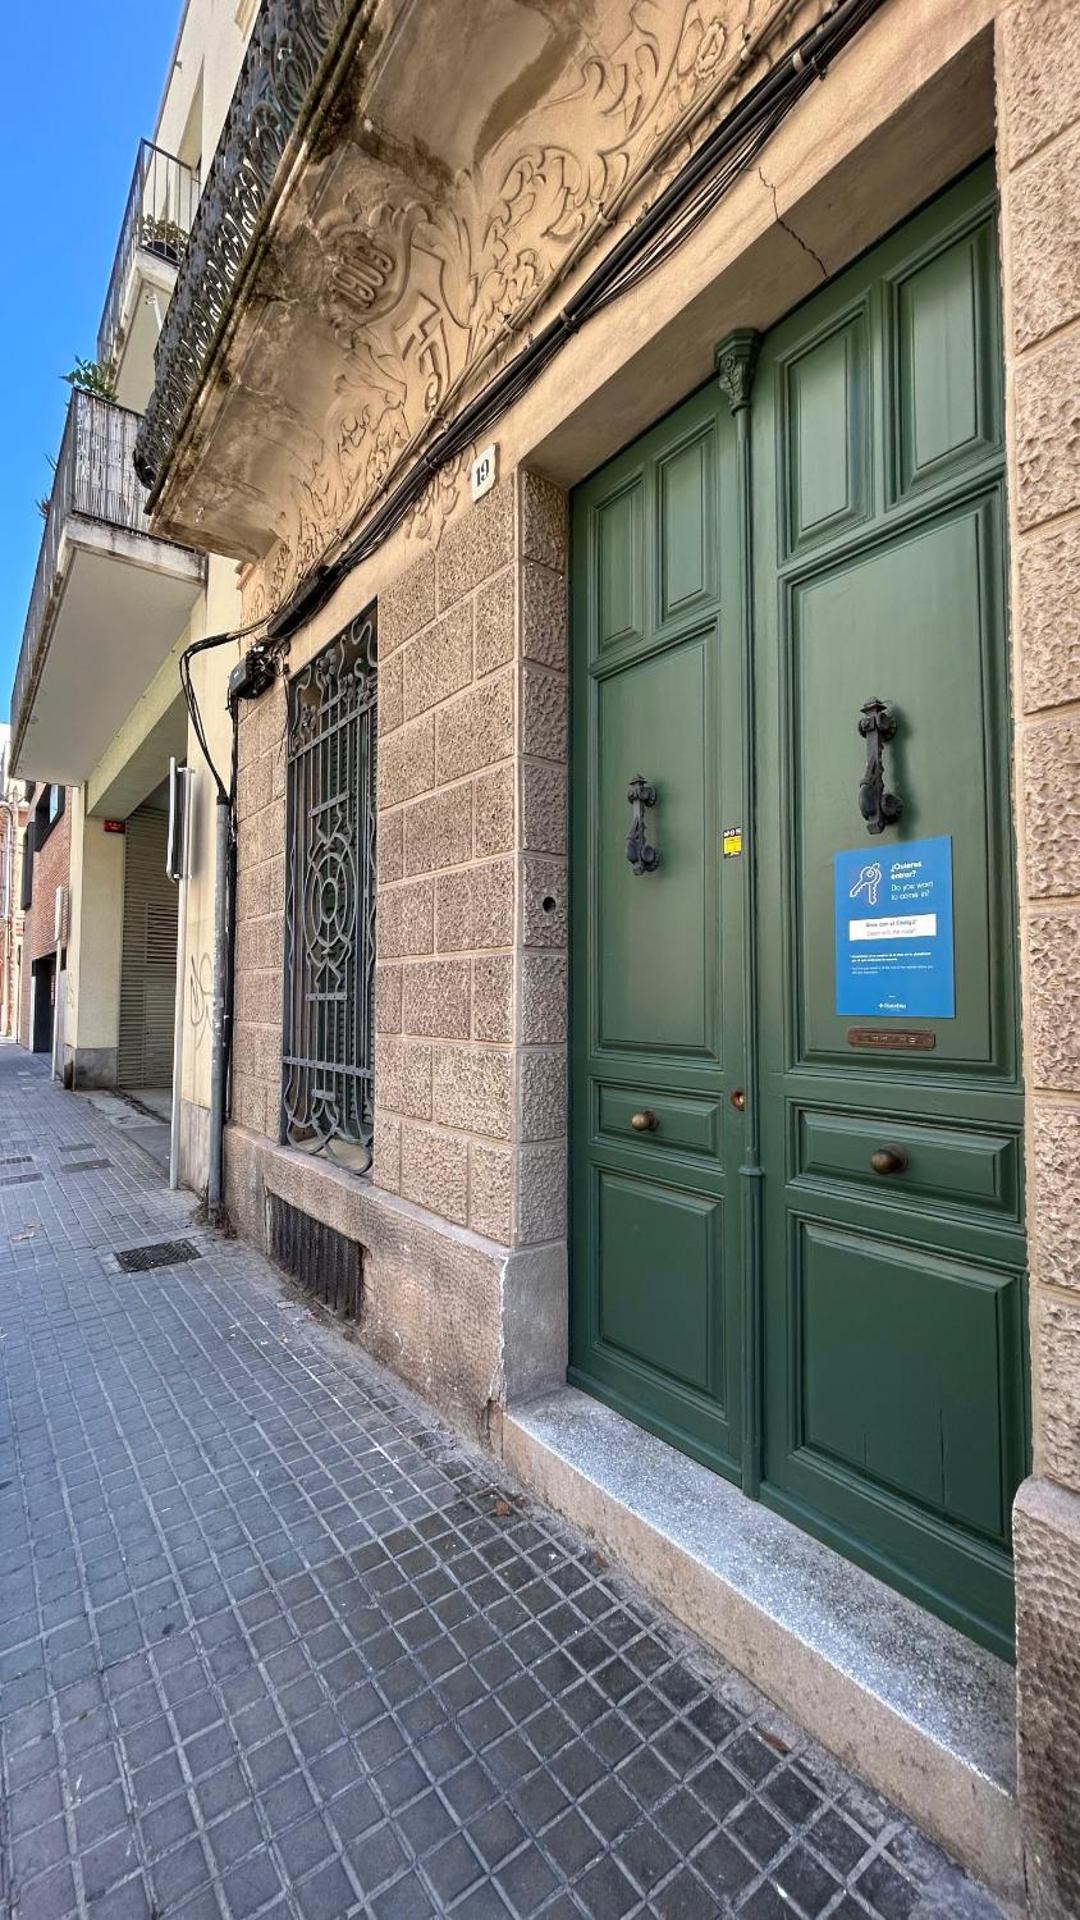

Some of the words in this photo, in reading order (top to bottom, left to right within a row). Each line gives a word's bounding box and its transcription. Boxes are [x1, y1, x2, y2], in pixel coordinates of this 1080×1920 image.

[476, 459, 489, 487] 19
[890, 860, 922, 872] ¿Quieres
[890, 870, 916, 880] entrar?
[891, 884, 901, 892] Do
[903, 884, 915, 892] you
